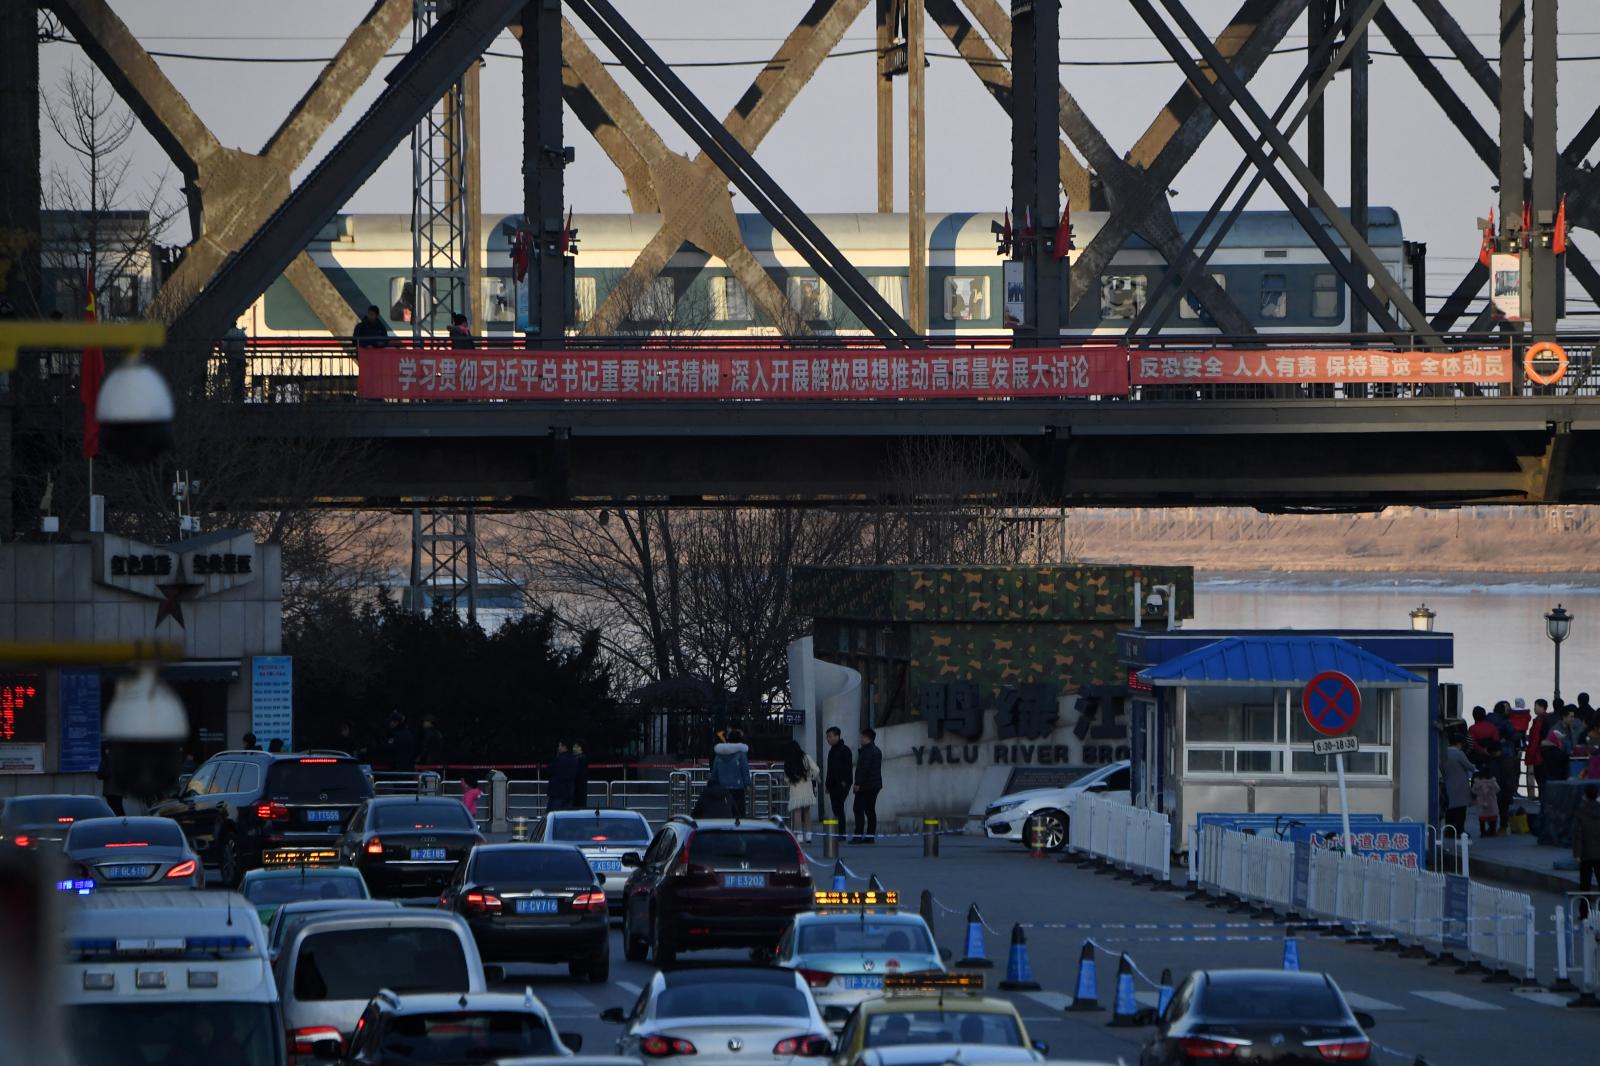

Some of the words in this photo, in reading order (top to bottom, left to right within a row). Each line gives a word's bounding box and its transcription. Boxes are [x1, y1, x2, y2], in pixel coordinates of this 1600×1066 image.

[398, 358, 720, 393] 学习贯彻习近平总书记重要讲话精神
[731, 356, 1090, 392] 深入开展解放思想推动高质量发展大讨论
[1140, 356, 1224, 378] 反恐安全
[1233, 356, 1317, 377] 人人有责
[1326, 355, 1411, 377] 保持警觉
[1420, 355, 1504, 377] 全体动员
[911, 744, 979, 766] YALU
[993, 744, 1070, 765] RIVER
